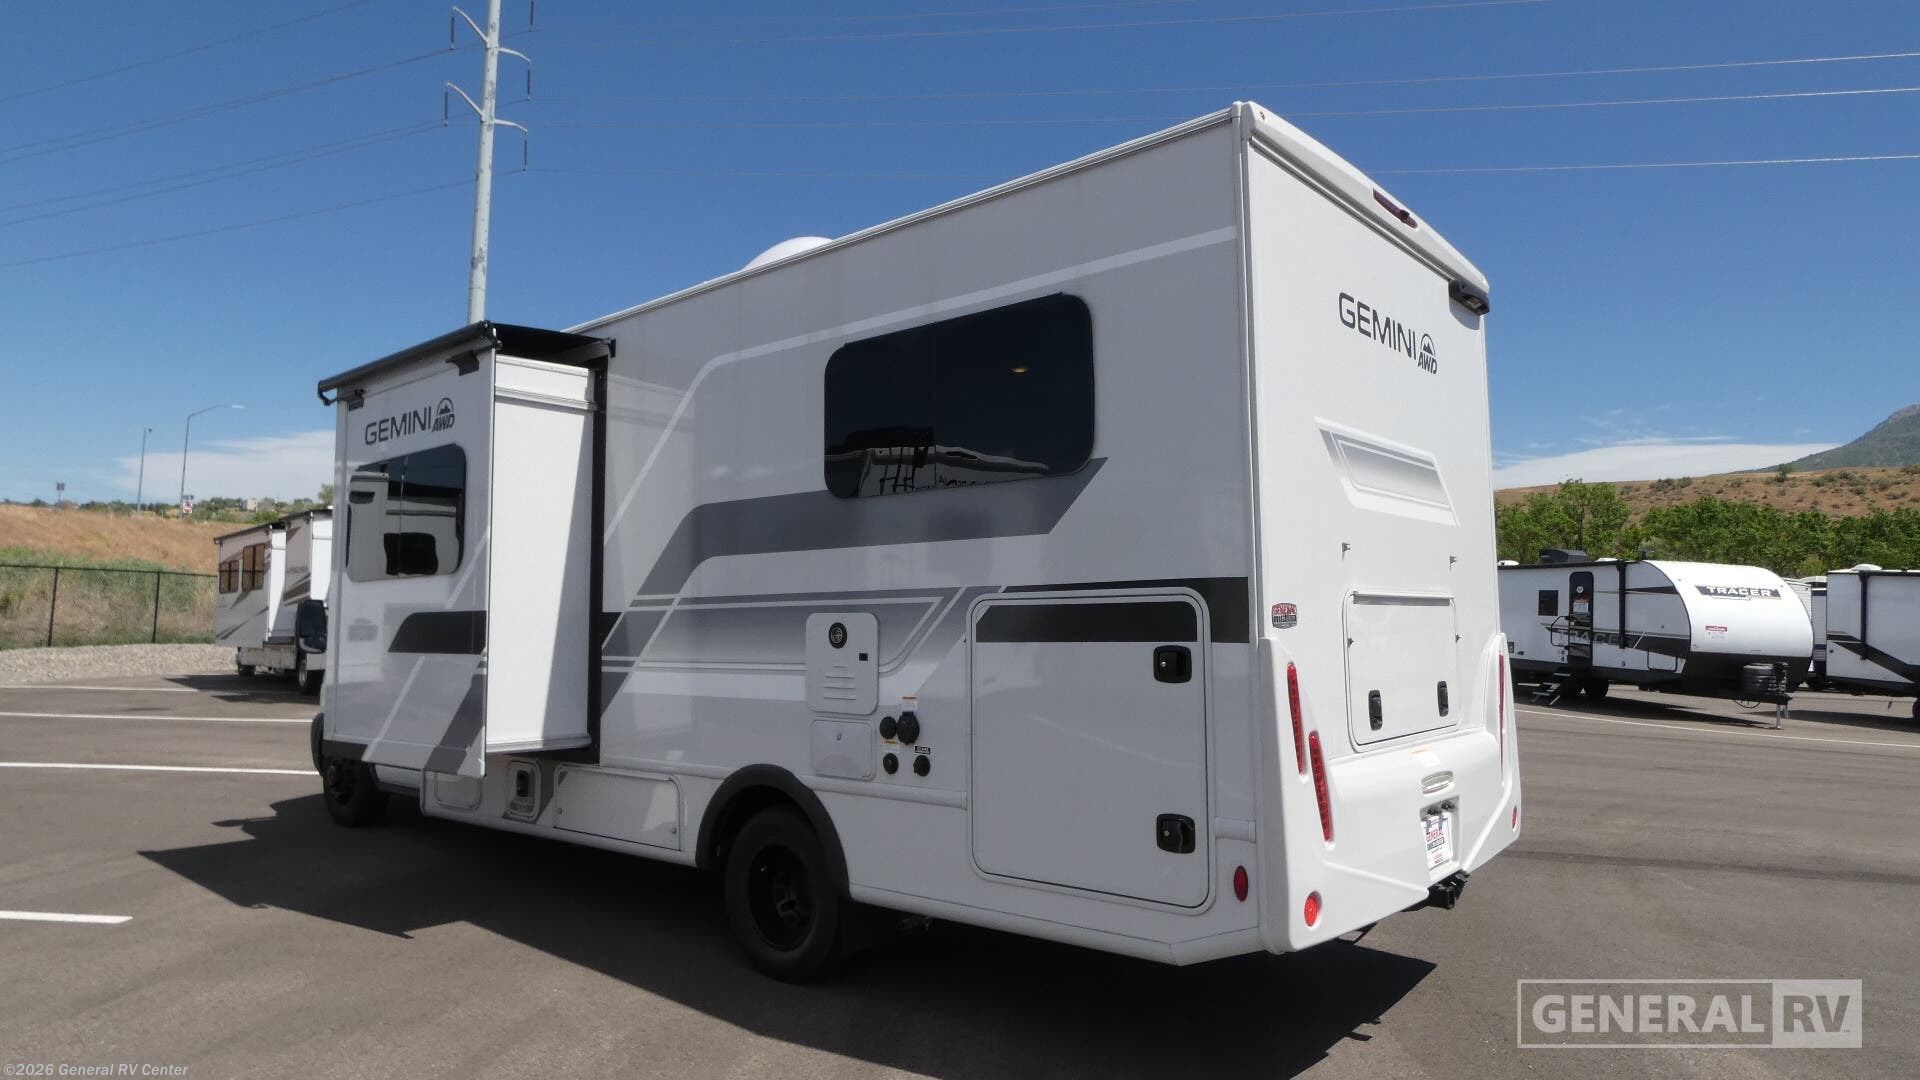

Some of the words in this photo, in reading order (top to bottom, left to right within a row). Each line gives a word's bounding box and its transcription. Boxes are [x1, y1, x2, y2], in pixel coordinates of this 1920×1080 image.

[1339, 292, 1417, 360] GEMINI
[1417, 351, 1438, 375] AWD
[365, 406, 432, 445] GEMINI
[432, 413, 455, 432] AWD
[1706, 586, 1772, 597] TRACER
